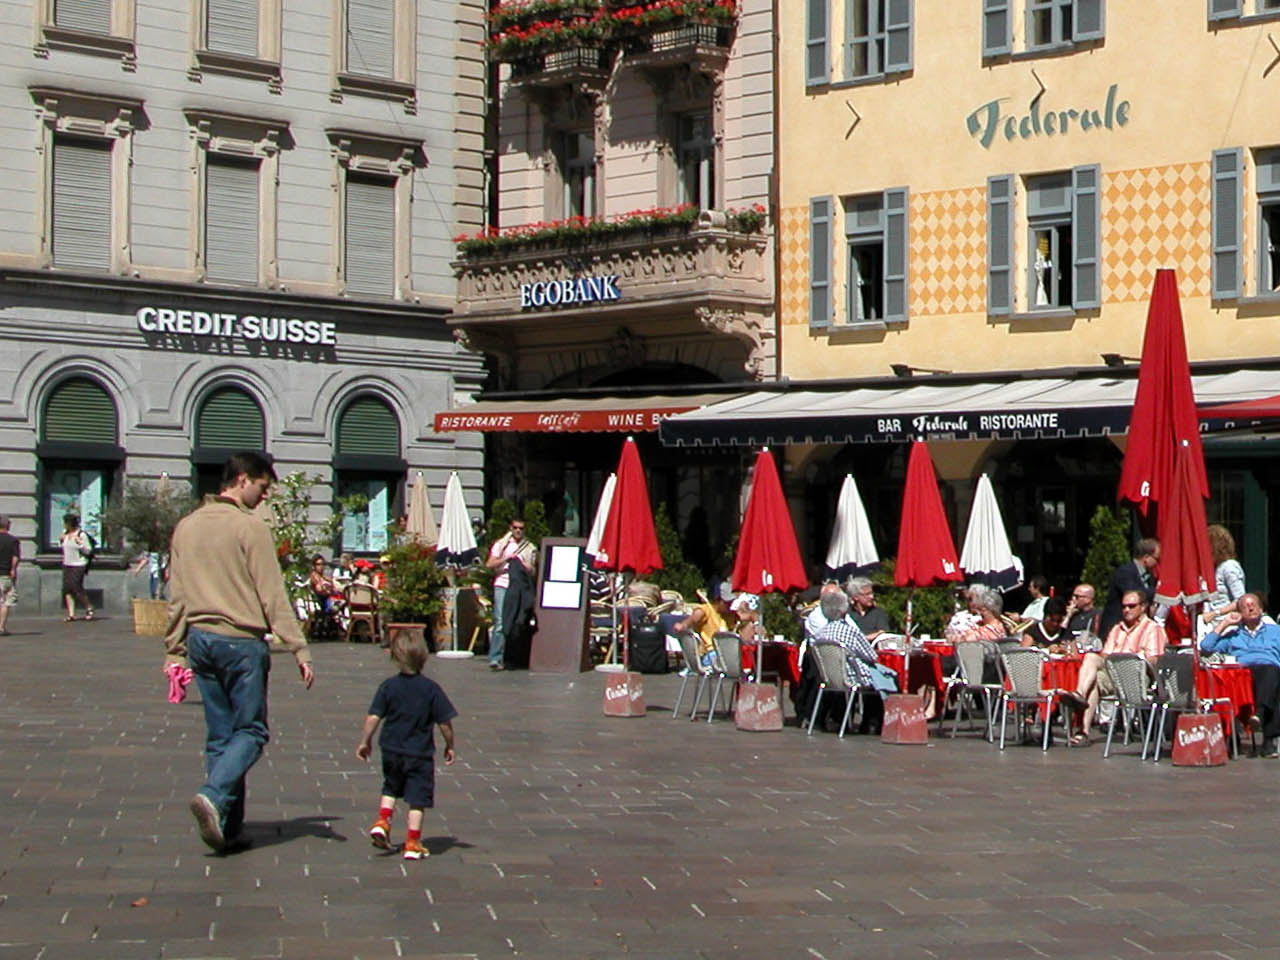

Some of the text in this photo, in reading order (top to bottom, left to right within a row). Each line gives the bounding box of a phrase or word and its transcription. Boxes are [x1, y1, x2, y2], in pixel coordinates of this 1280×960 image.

[966, 84, 1131, 149] Federale
[520, 276, 620, 308] EGOBANK
[138, 307, 337, 345] CREDIT SUISSE
[441, 416, 513, 428] RISTORANTE
[608, 413, 643, 426] WINE
[877, 418, 902, 432] BAR
[980, 413, 1059, 430] RISTORANTE
